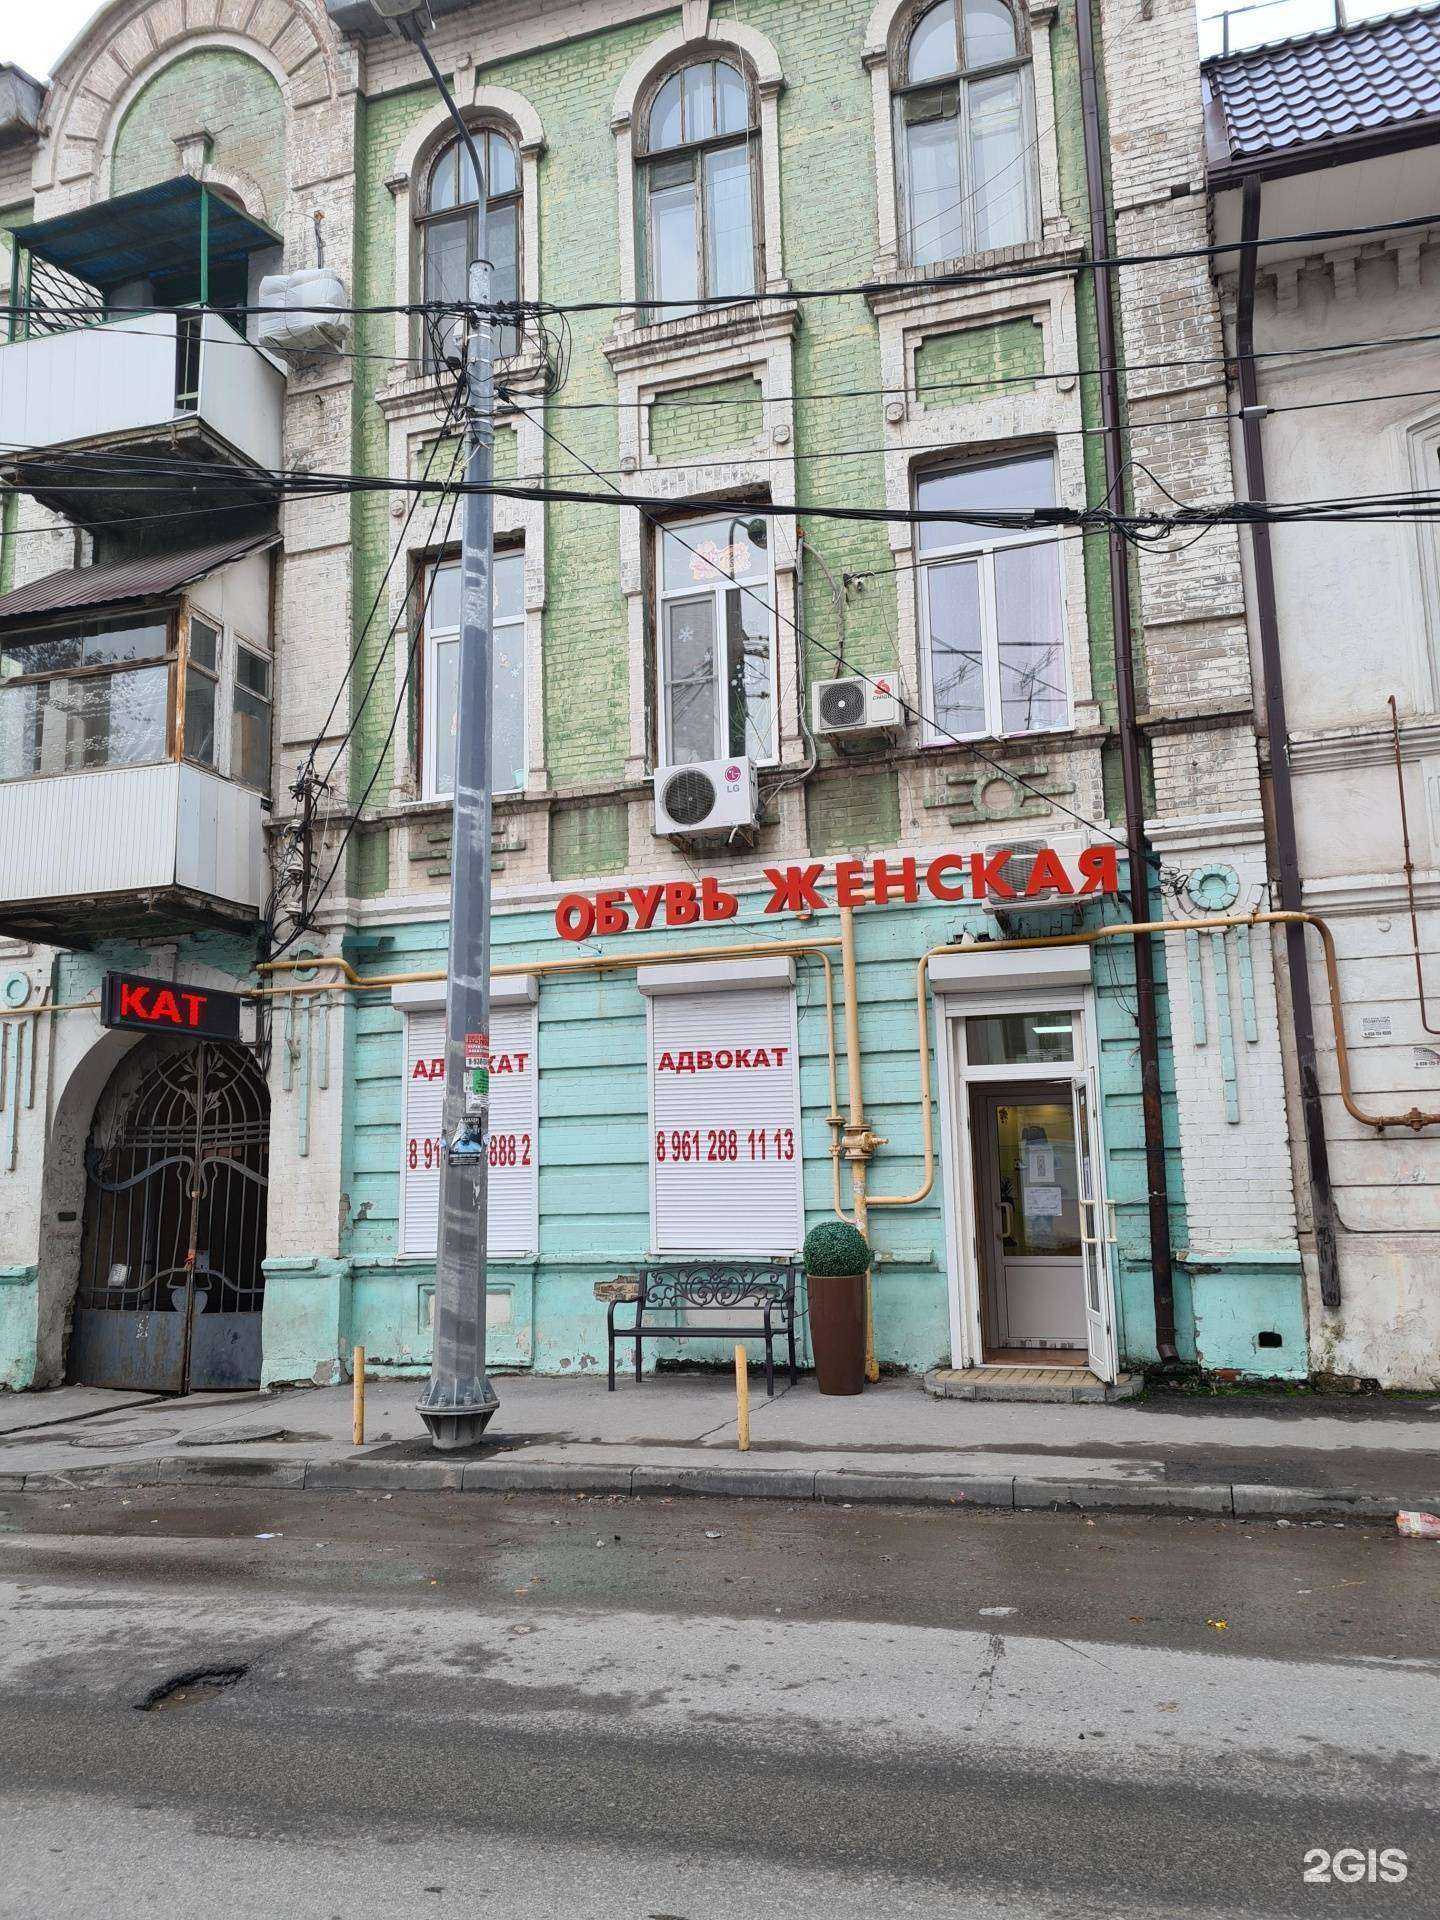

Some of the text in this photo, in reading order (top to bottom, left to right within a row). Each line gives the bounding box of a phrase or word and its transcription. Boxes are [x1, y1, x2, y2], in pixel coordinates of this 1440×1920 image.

[727, 784, 740, 793] LG
[555, 845, 1119, 941] ОБУВЬ ЖЕНСКАЯ
[120, 983, 208, 1028] КАТ
[658, 1048, 788, 1074] АДВОКАТ
[409, 1138, 418, 1169] 8
[521, 1134, 531, 1166] 2
[656, 1128, 794, 1162] 8 961 288 11 13
